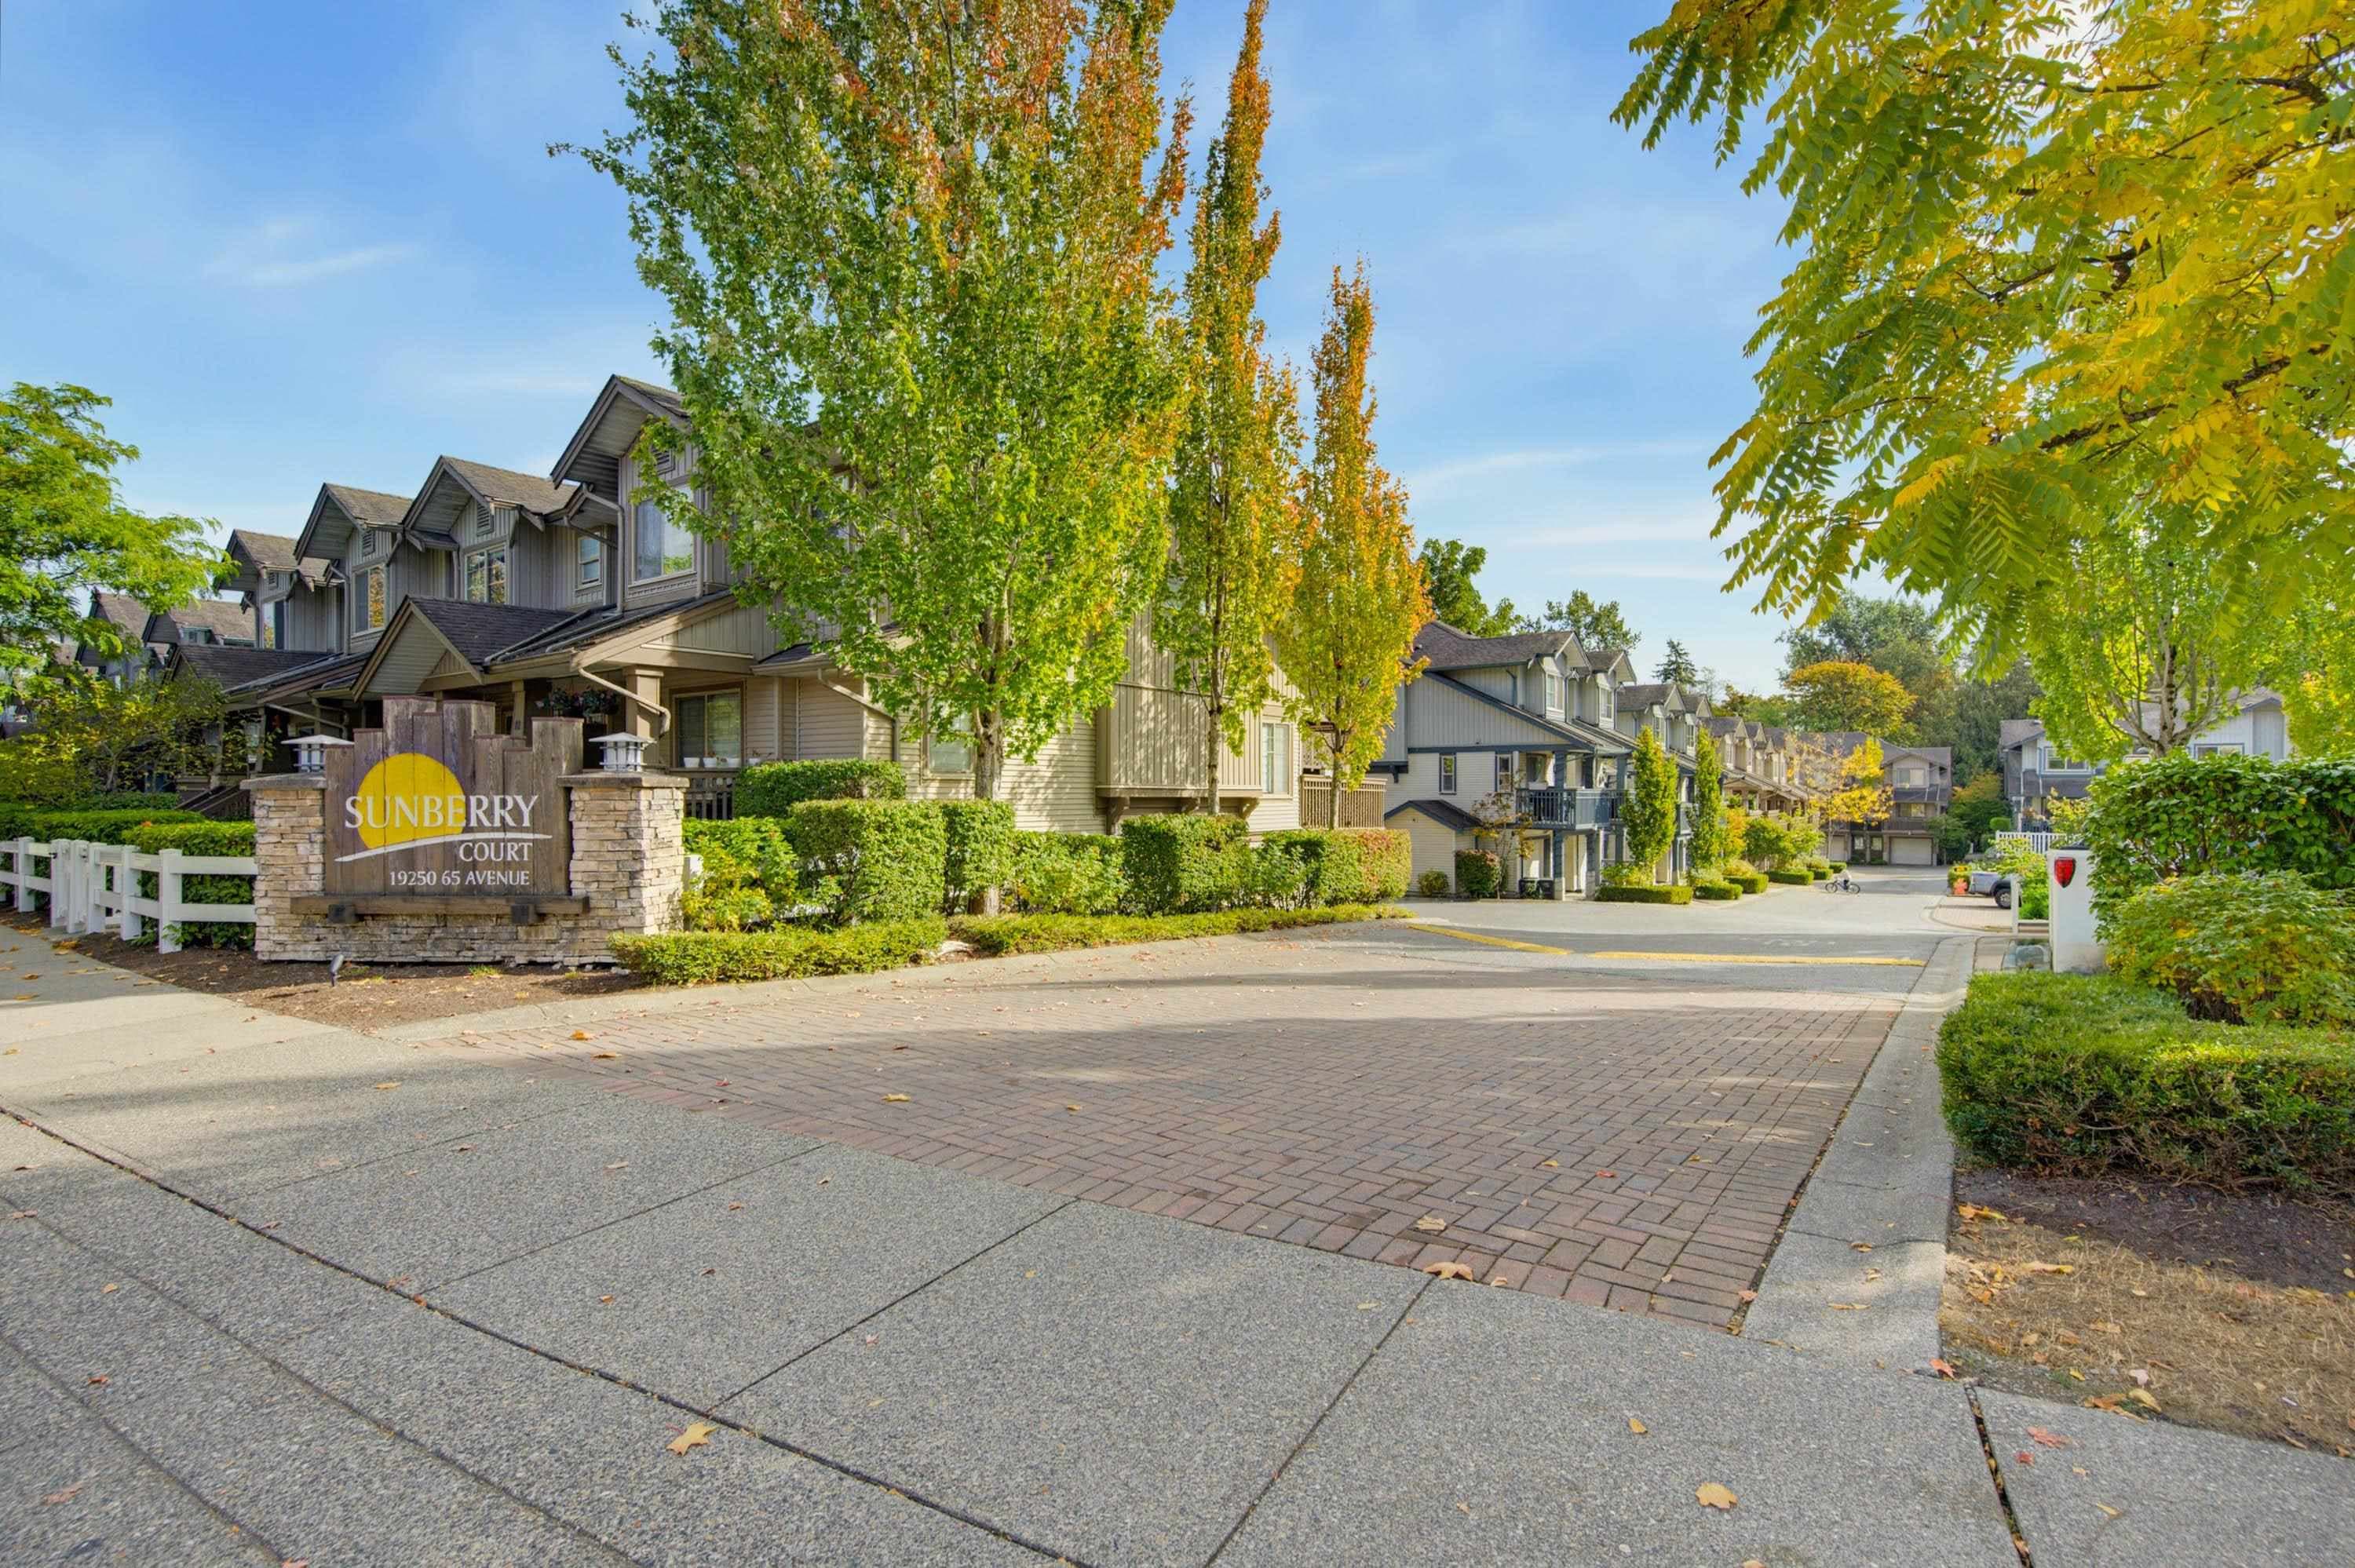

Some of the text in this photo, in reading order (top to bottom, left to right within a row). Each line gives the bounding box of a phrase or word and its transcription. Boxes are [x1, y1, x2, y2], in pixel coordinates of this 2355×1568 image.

[345, 794, 539, 828] SUNBERRY
[458, 841, 533, 862] COURT
[389, 870, 530, 886] 19250 65 AVENUE
